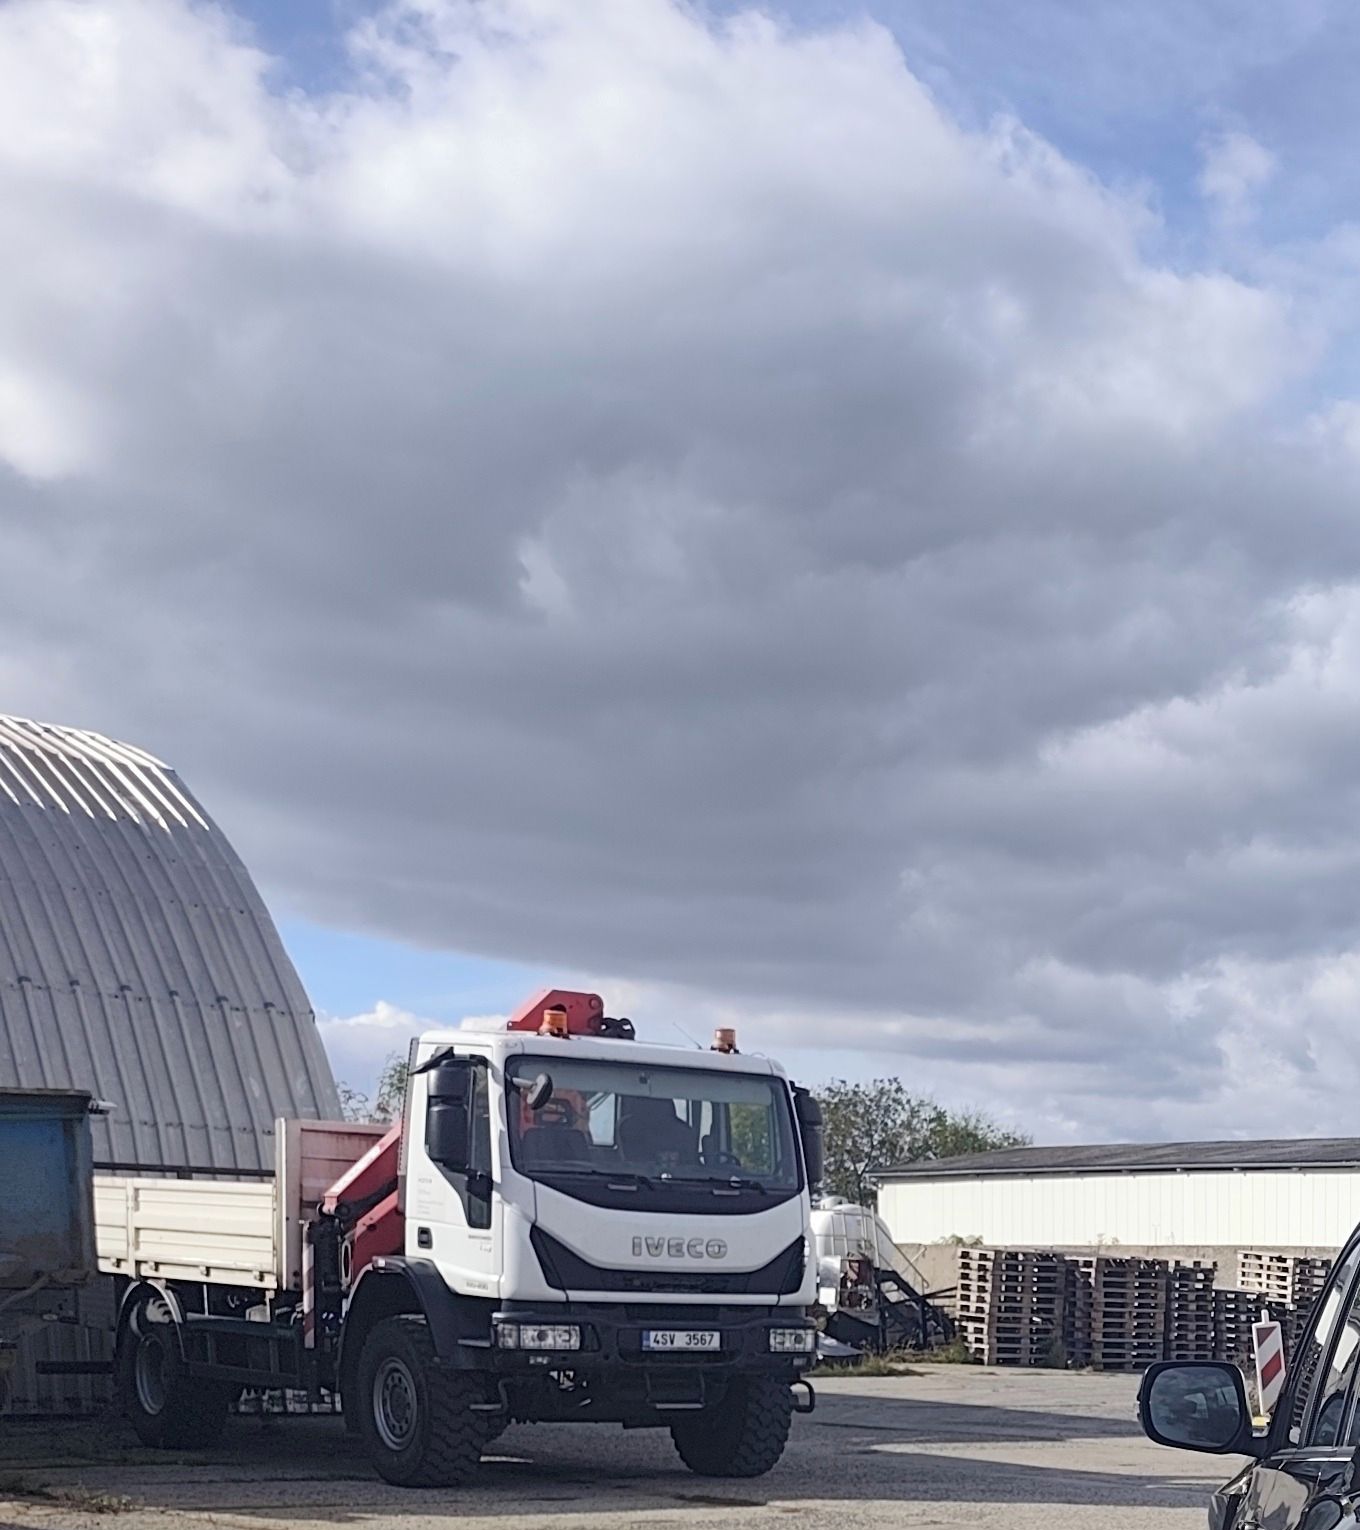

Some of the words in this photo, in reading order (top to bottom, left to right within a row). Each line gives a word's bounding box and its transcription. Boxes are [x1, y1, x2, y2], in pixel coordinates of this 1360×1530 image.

[632, 1236, 728, 1259] IVECO
[653, 1333, 676, 1346] 4SV
[685, 1333, 715, 1346] 3567
